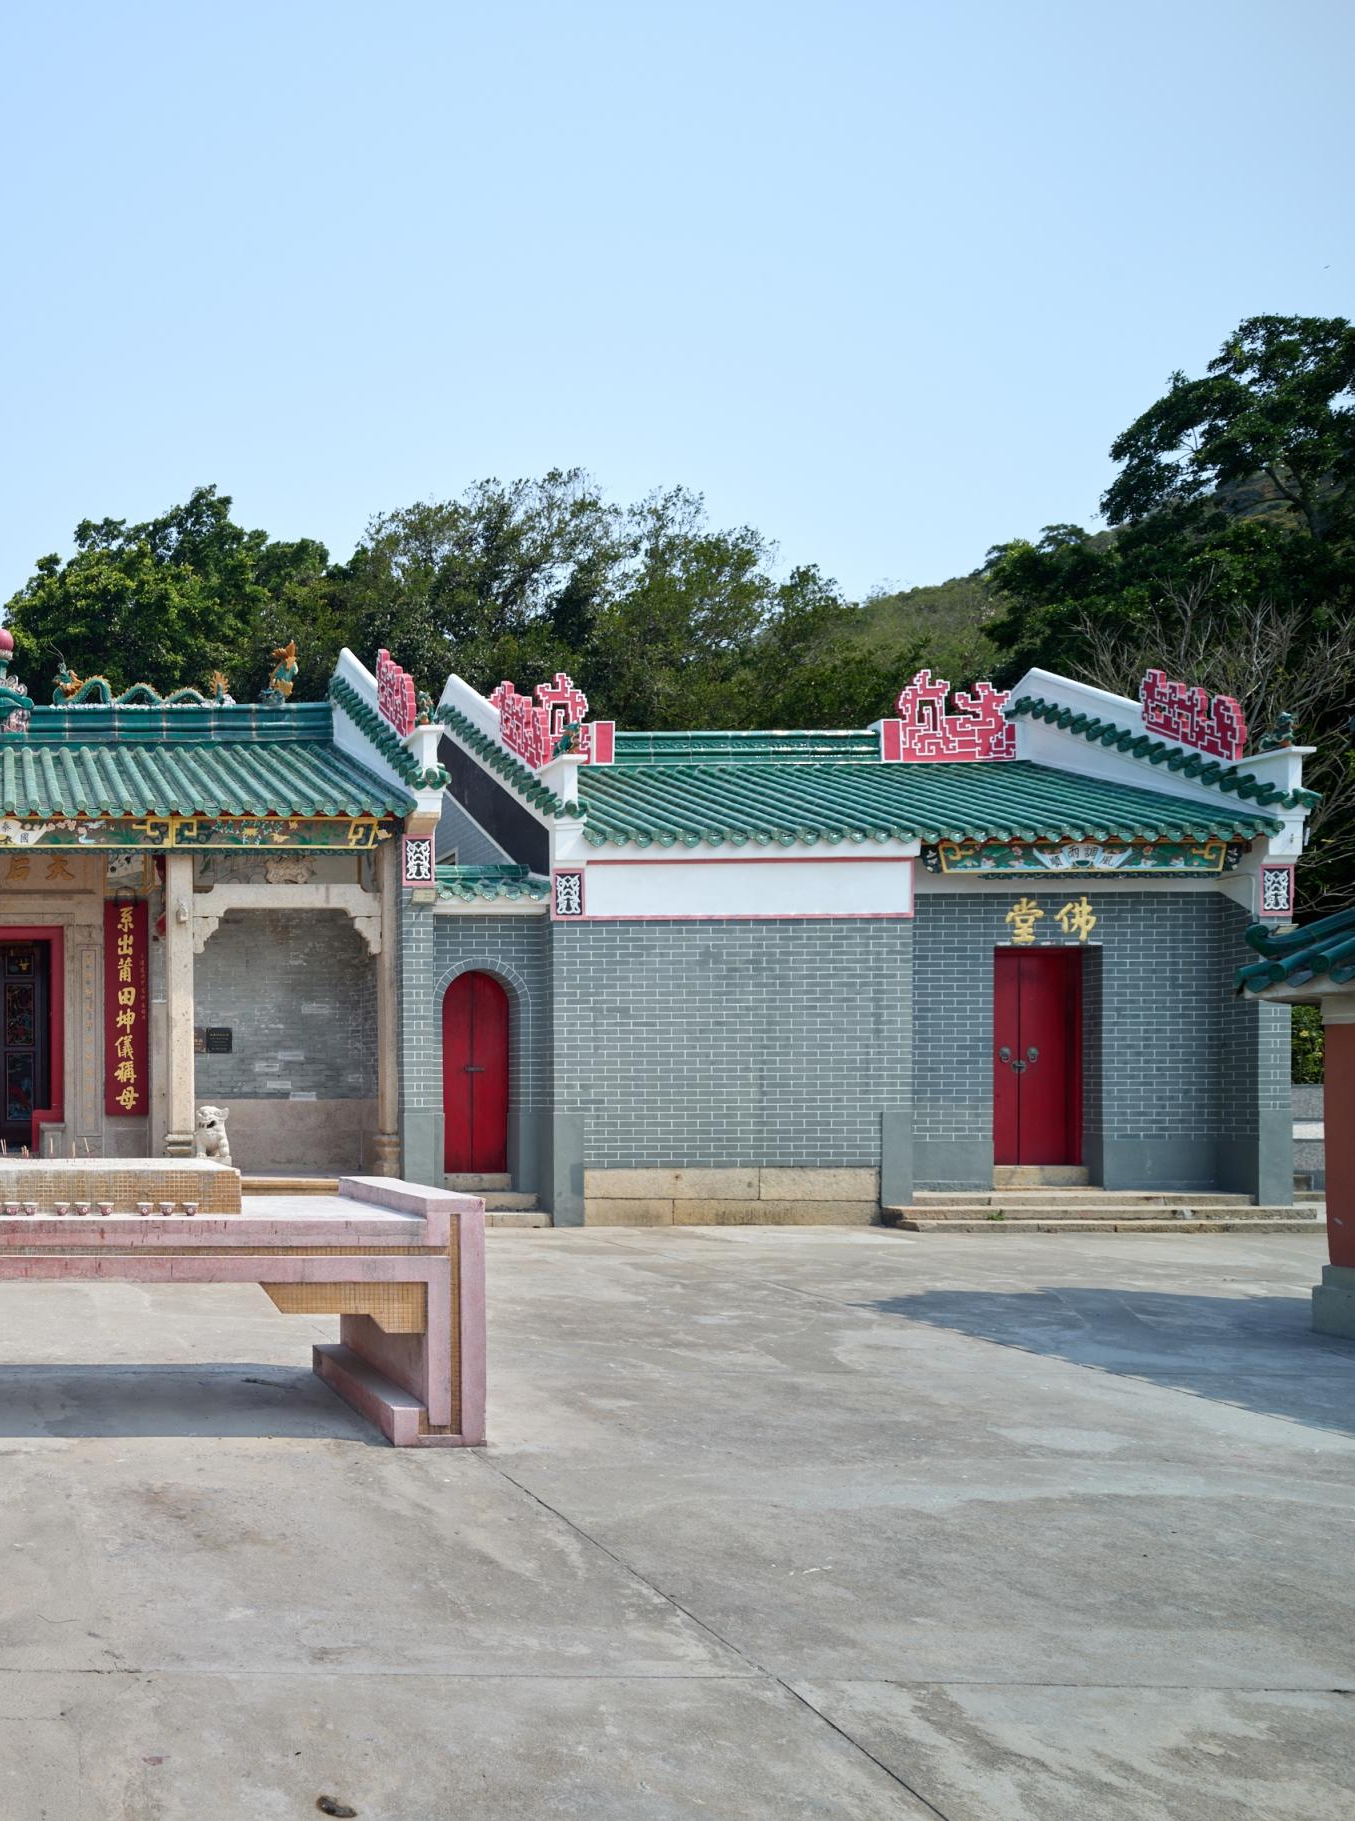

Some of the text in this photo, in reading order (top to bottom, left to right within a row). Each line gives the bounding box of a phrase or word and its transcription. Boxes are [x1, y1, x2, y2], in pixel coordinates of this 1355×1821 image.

[1005, 896, 1098, 944] 佛堂
[114, 906, 139, 1110] 系出莆田坤儀稱母
